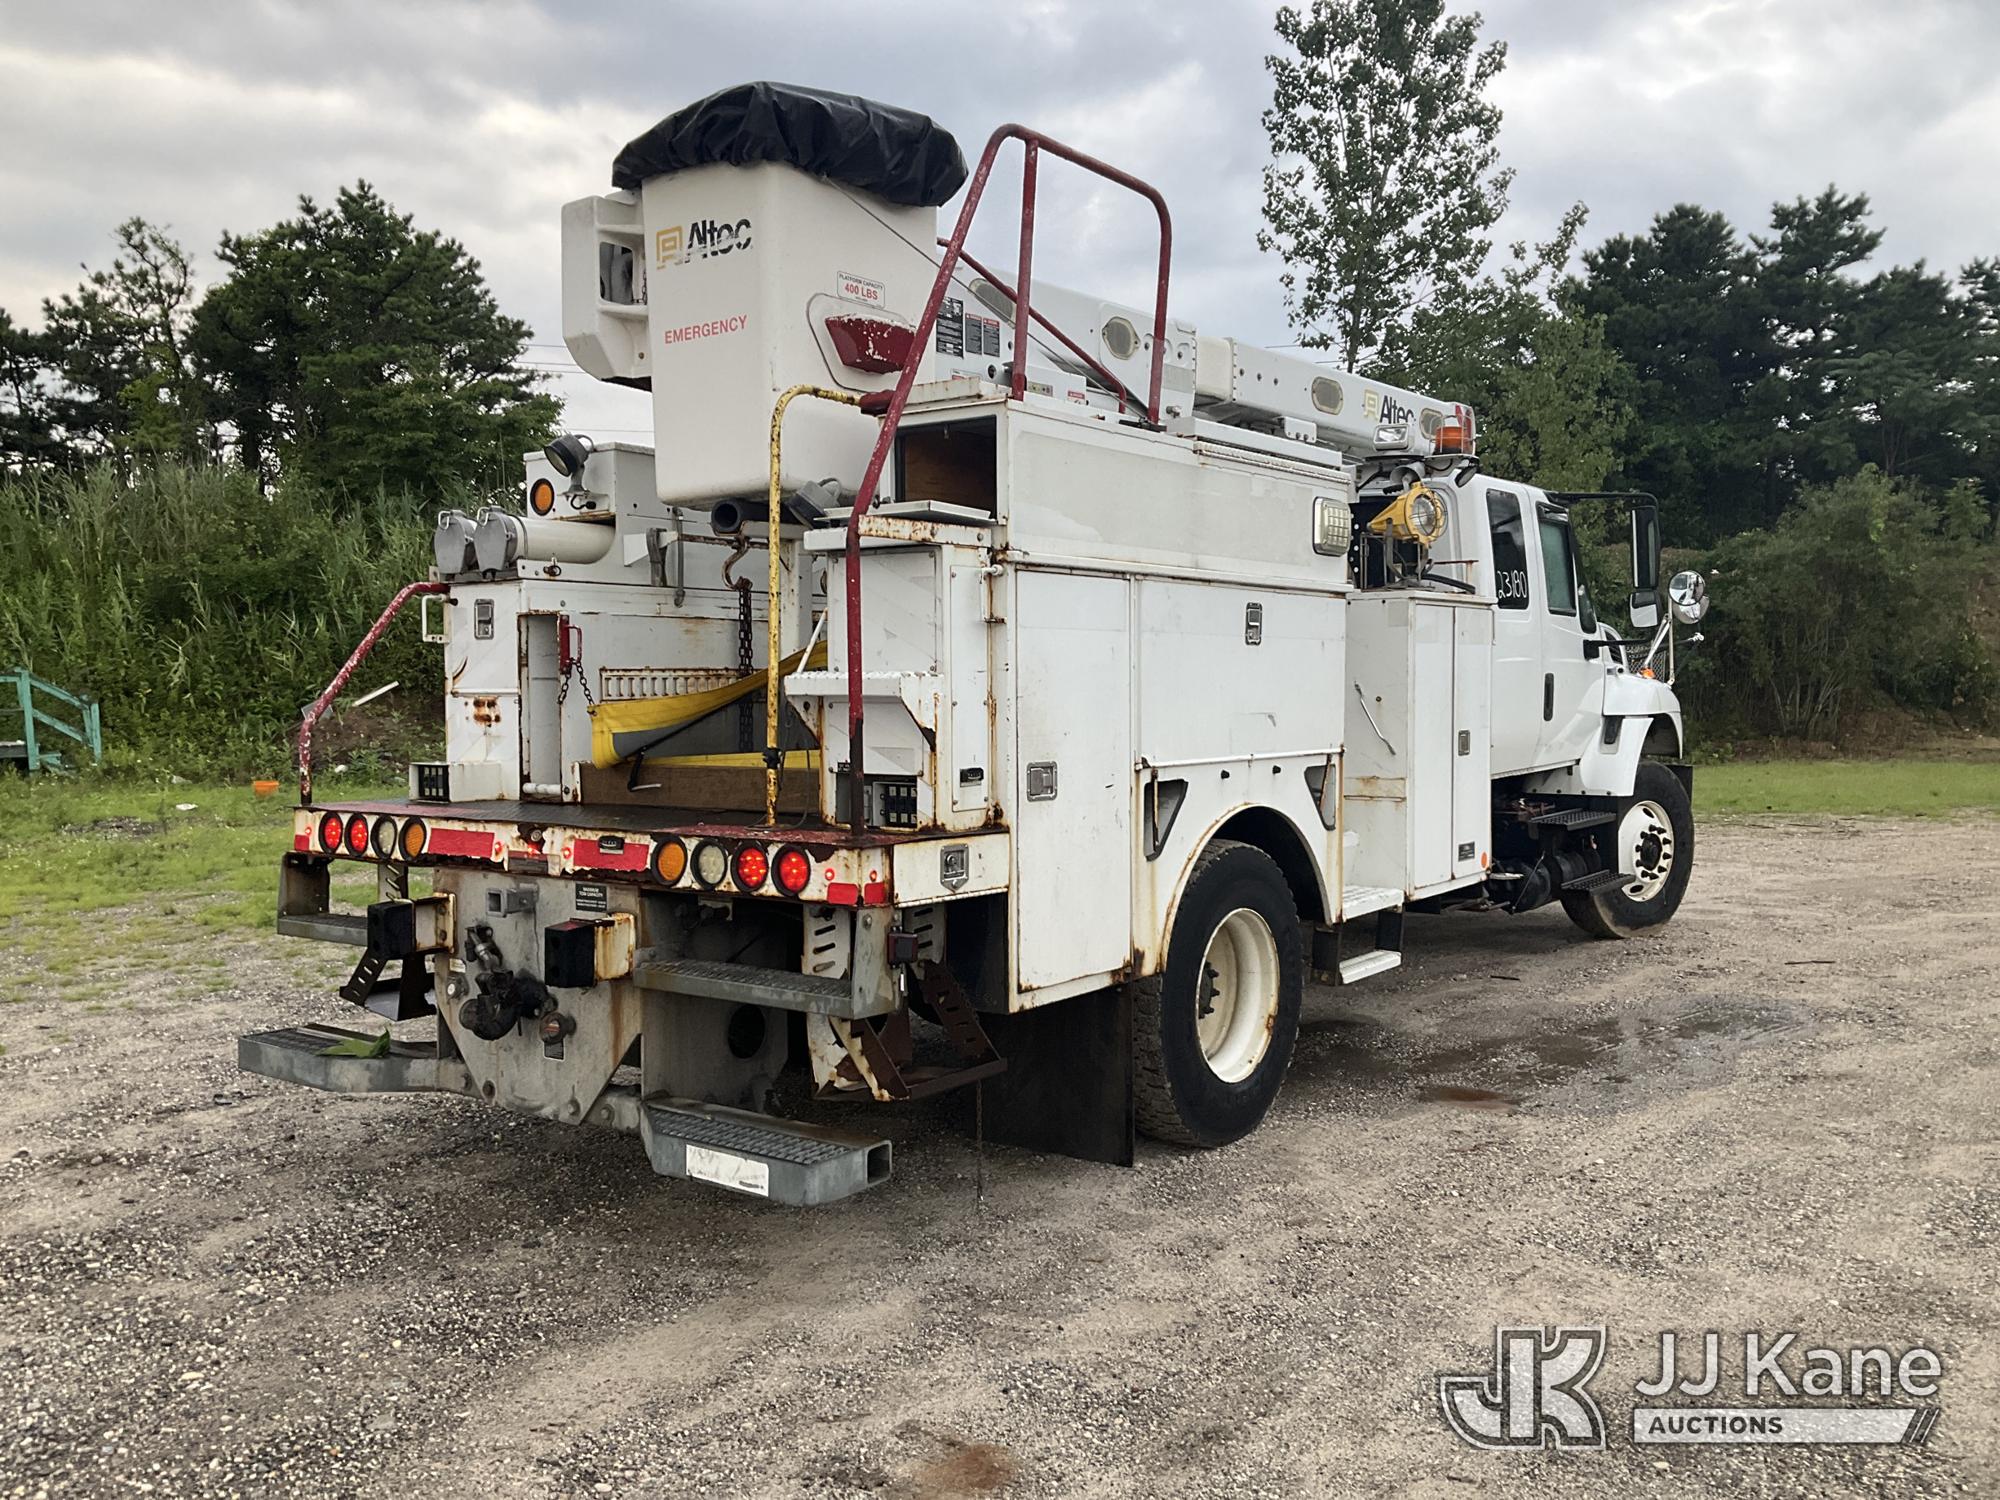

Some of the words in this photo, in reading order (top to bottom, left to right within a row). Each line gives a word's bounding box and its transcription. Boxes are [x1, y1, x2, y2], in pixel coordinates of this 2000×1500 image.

[684, 218, 752, 264] Altec
[845, 283, 859, 295] 400
[861, 286, 878, 300] LBS
[665, 314, 747, 344] EMERGENCY
[1497, 570, 1527, 599] 23180
